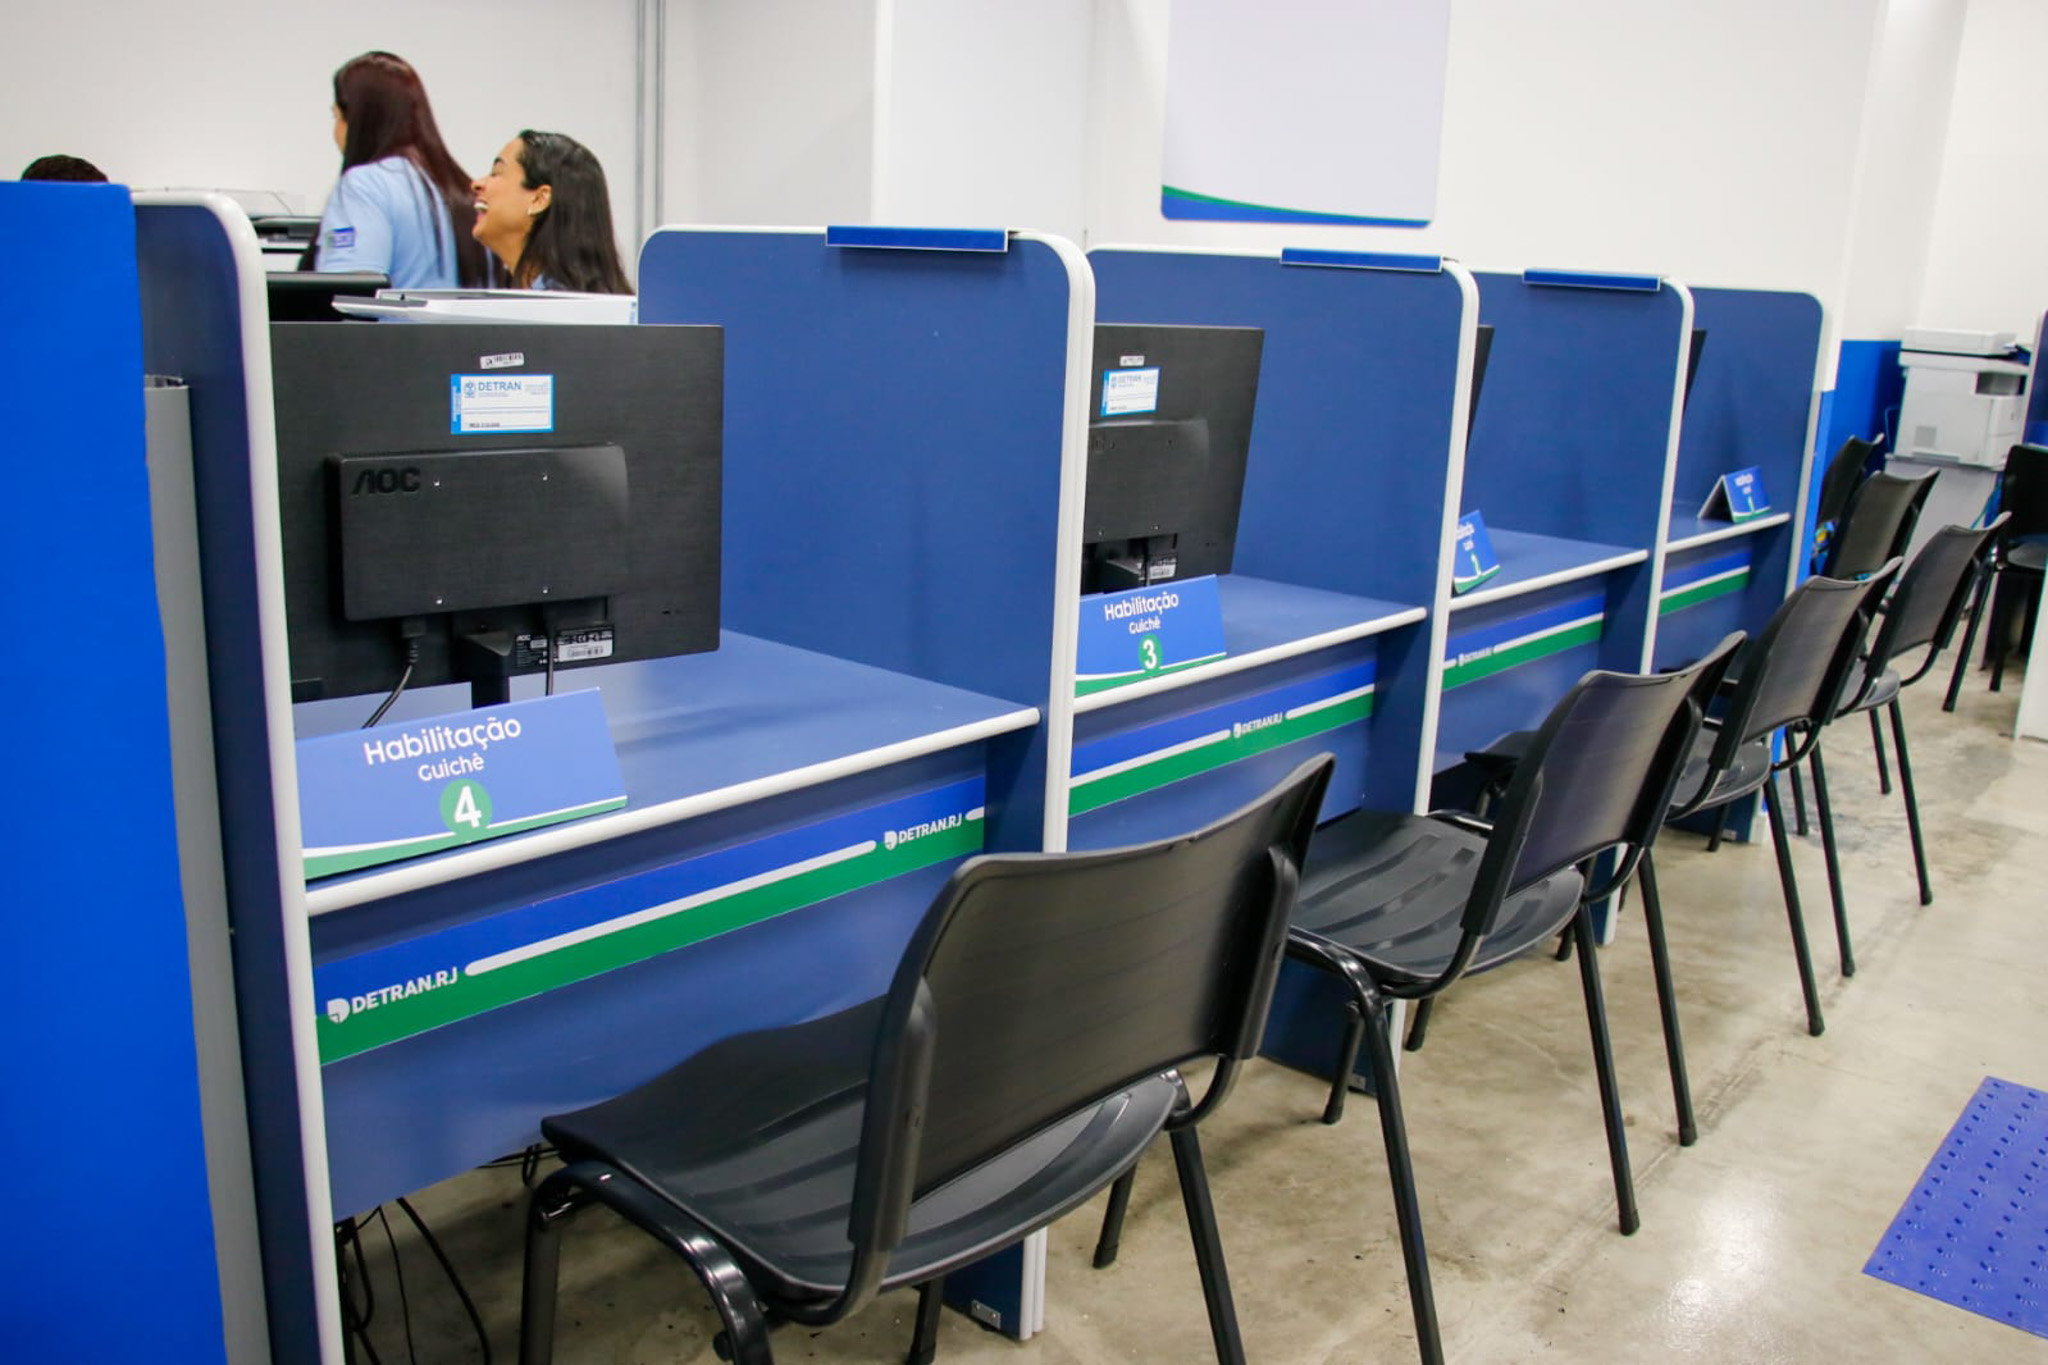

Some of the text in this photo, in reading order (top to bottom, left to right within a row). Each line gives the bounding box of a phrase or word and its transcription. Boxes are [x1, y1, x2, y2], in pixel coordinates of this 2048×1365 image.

[478, 381, 521, 391] DETRAN
[350, 467, 420, 494] AOC
[1104, 592, 1179, 621] Habilitação
[1143, 639, 1157, 669] 3
[363, 717, 521, 765] Habilitação
[418, 753, 484, 781] Guichê
[454, 786, 482, 828] 4
[899, 813, 962, 844] DETRAN.RJ
[352, 966, 459, 1014] DETRAN.RJ
